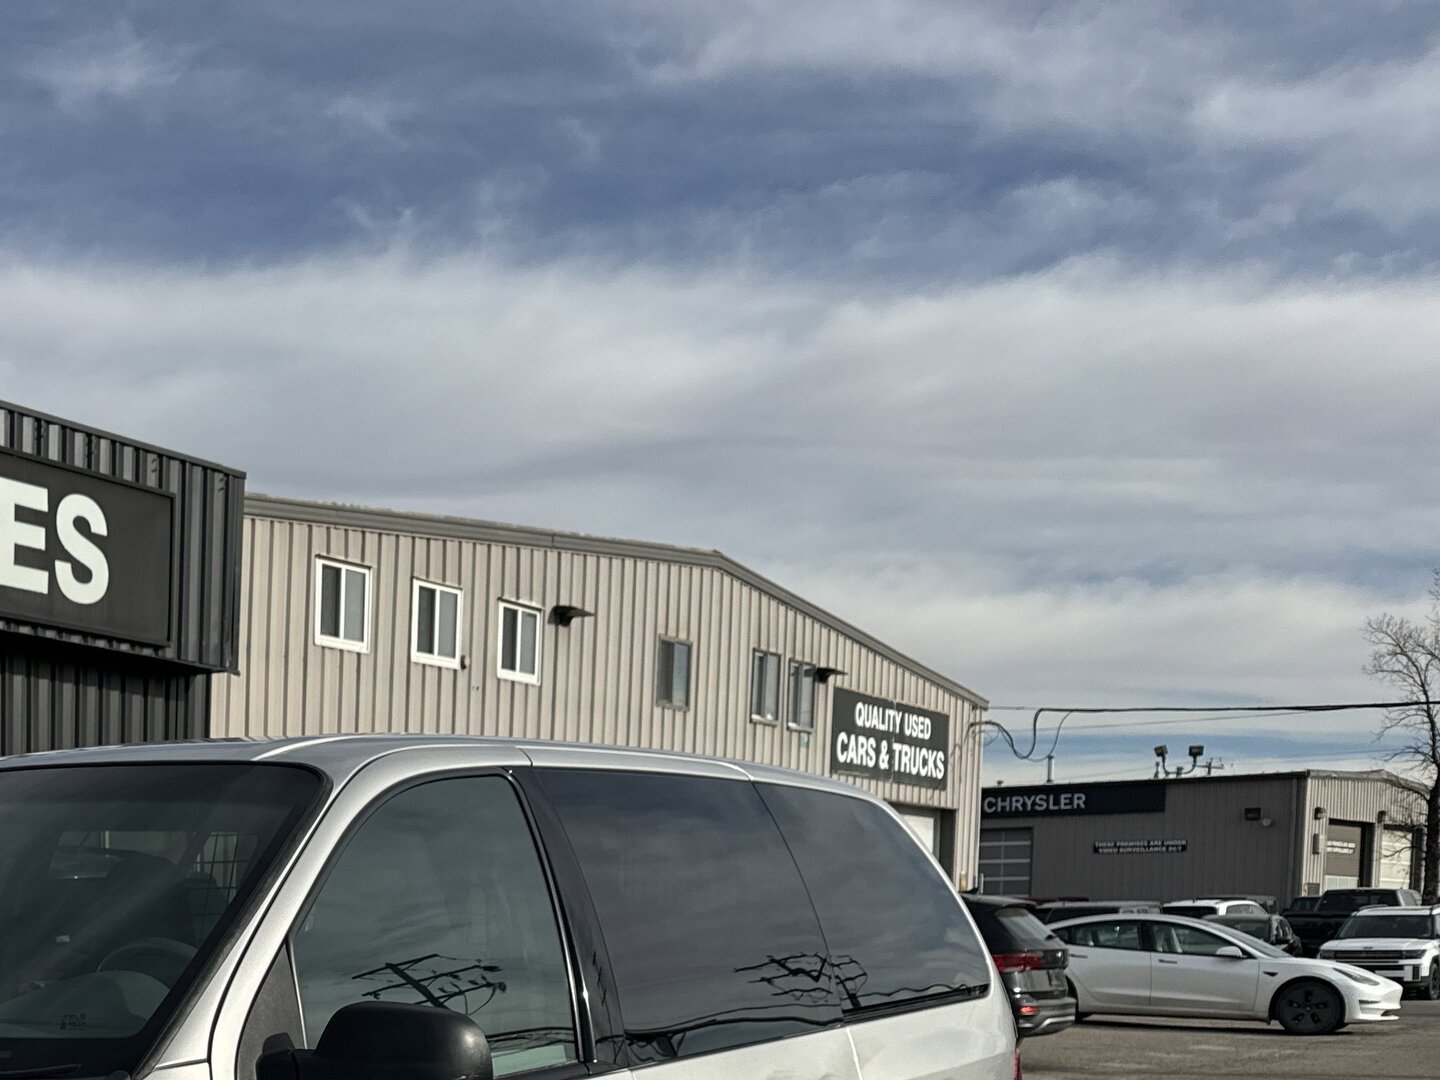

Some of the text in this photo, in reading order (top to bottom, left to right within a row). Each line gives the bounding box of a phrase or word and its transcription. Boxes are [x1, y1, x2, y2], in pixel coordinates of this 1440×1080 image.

[855, 701, 932, 740] QUALITY USED
[836, 731, 945, 780] CARS & TRUCKS
[983, 793, 1086, 813] CHRYSLER
